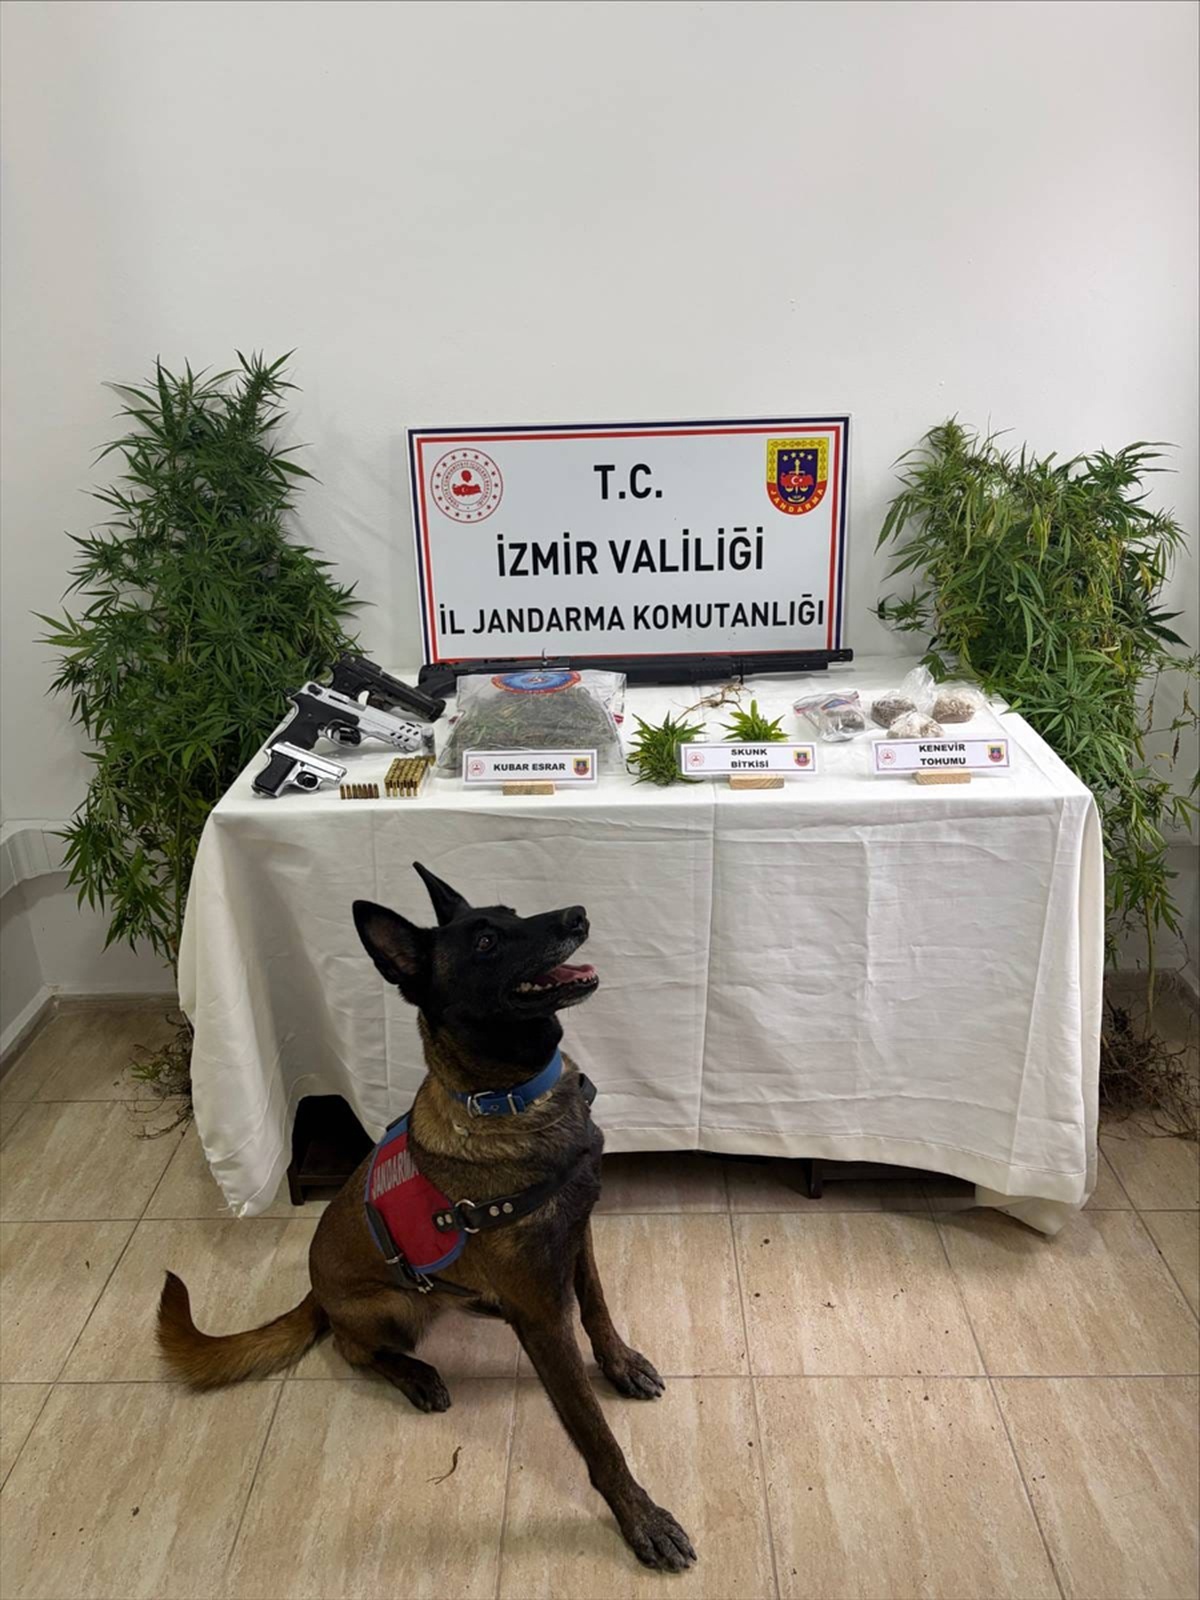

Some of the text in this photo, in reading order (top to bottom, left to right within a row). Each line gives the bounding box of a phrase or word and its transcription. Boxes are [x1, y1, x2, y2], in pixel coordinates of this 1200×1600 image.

[593, 463, 663, 501] T.C.
[770, 489, 824, 513] JANDARMA
[496, 526, 764, 577] İZMİR VALİLİĞİ
[439, 593, 825, 635] İL JANDARMA KOMUTANLIĞI
[731, 748, 767, 756] SKUNK
[919, 742, 966, 753] KENEVİR
[493, 762, 566, 771] KUBAR ESRAR
[731, 759, 769, 768] BİTKİSİ
[920, 757, 966, 766] TOHUMU
